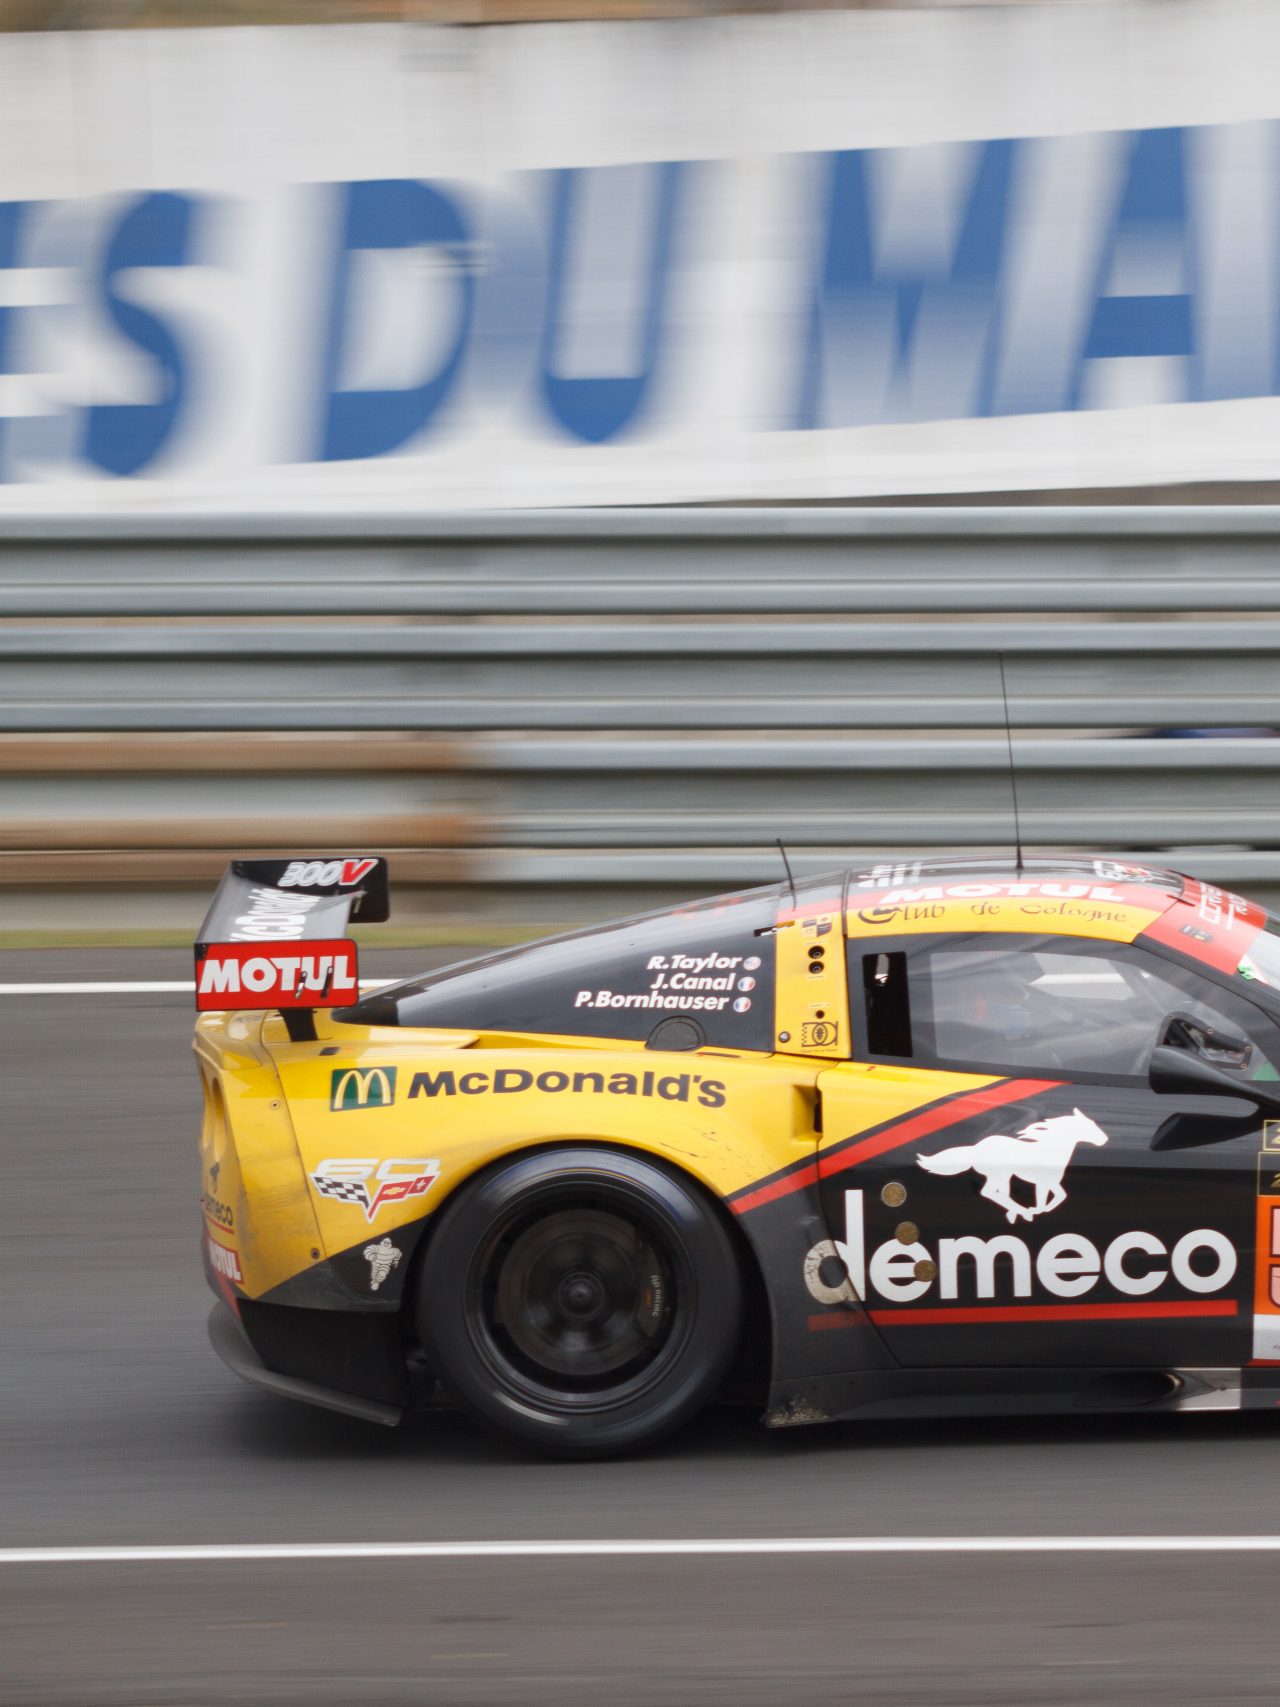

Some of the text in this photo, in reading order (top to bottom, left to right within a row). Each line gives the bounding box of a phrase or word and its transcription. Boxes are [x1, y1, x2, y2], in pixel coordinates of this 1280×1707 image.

[305, 160, 690, 464] DU
[277, 858, 379, 887] 300V
[879, 883, 1126, 904] MOTUL
[971, 901, 1000, 916] de
[1020, 902, 1128, 923] Cologne
[199, 955, 356, 994] MOTUL
[647, 953, 742, 973] R.Taylor
[651, 974, 736, 990] J.Canal
[574, 991, 729, 1011] P.Bornhauser
[407, 1069, 728, 1108] McDonald's
[803, 1189, 1238, 1305] demeco
